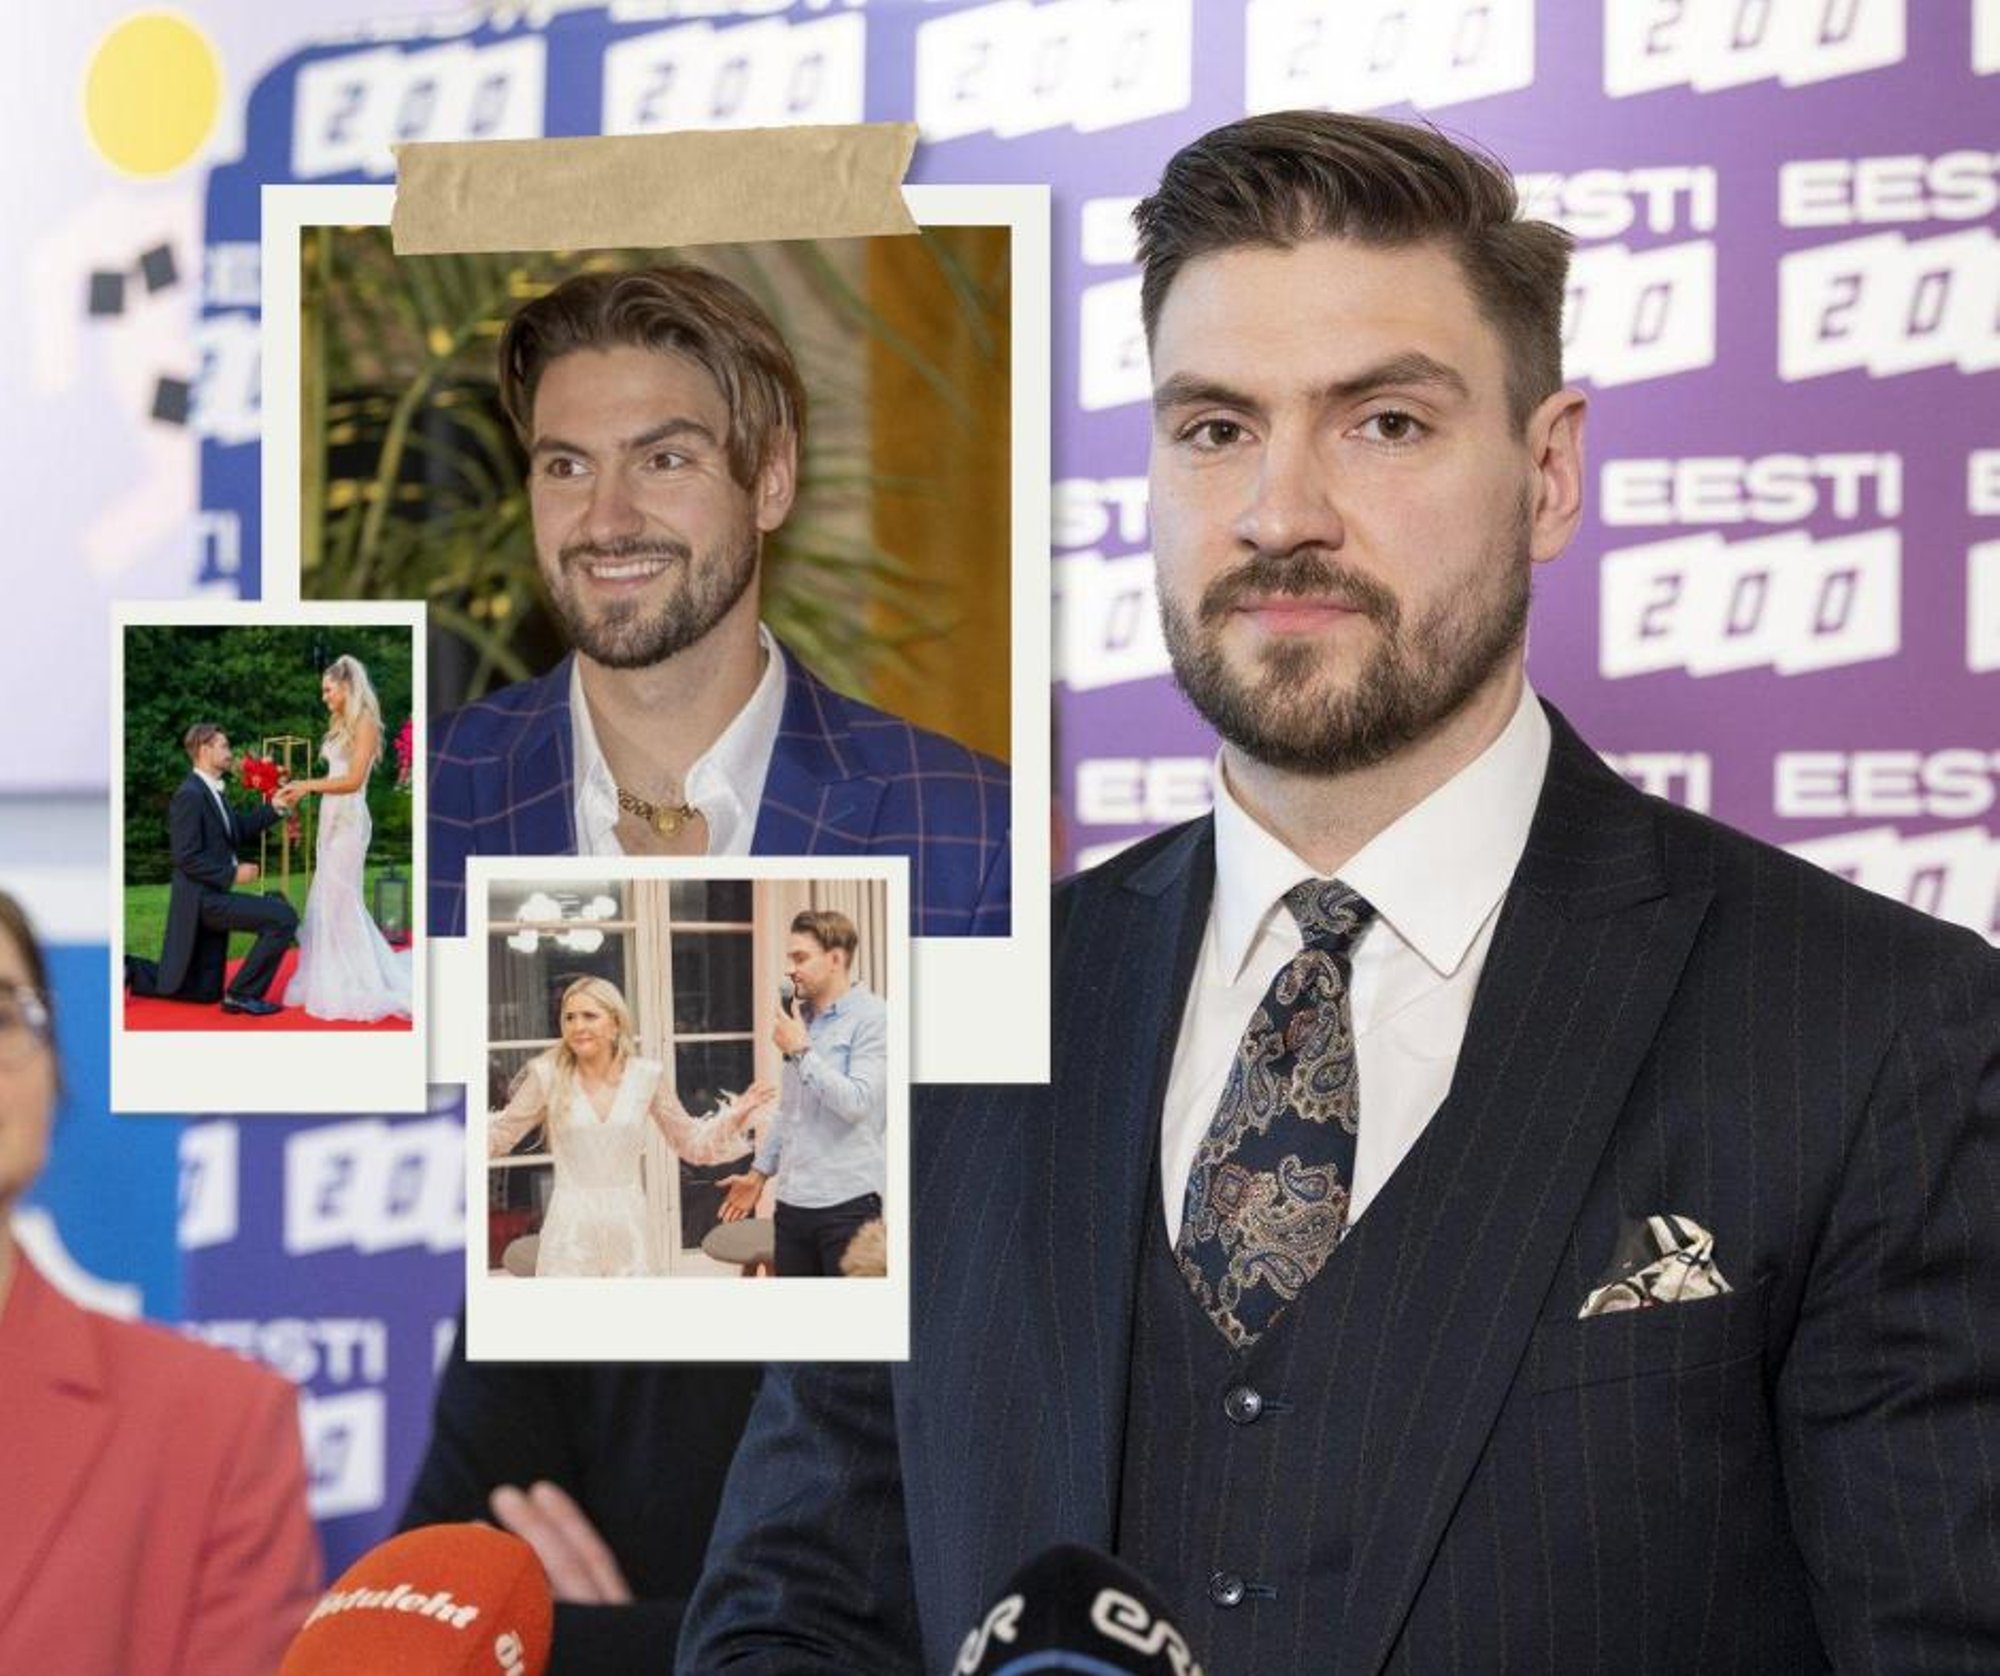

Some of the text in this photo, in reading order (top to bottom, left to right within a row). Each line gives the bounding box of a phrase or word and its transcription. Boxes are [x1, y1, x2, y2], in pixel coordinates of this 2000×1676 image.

[954, 27, 1152, 101] 200
[1287, 4, 1491, 79] 200
[326, 71, 509, 144] 200
[636, 51, 826, 126] 200
[1780, 150, 2000, 228] EES
[1819, 269, 2000, 341] 20
[1601, 452, 1903, 526] EESTI
[1639, 567, 1858, 641] 200
[1775, 748, 2000, 820] EES
